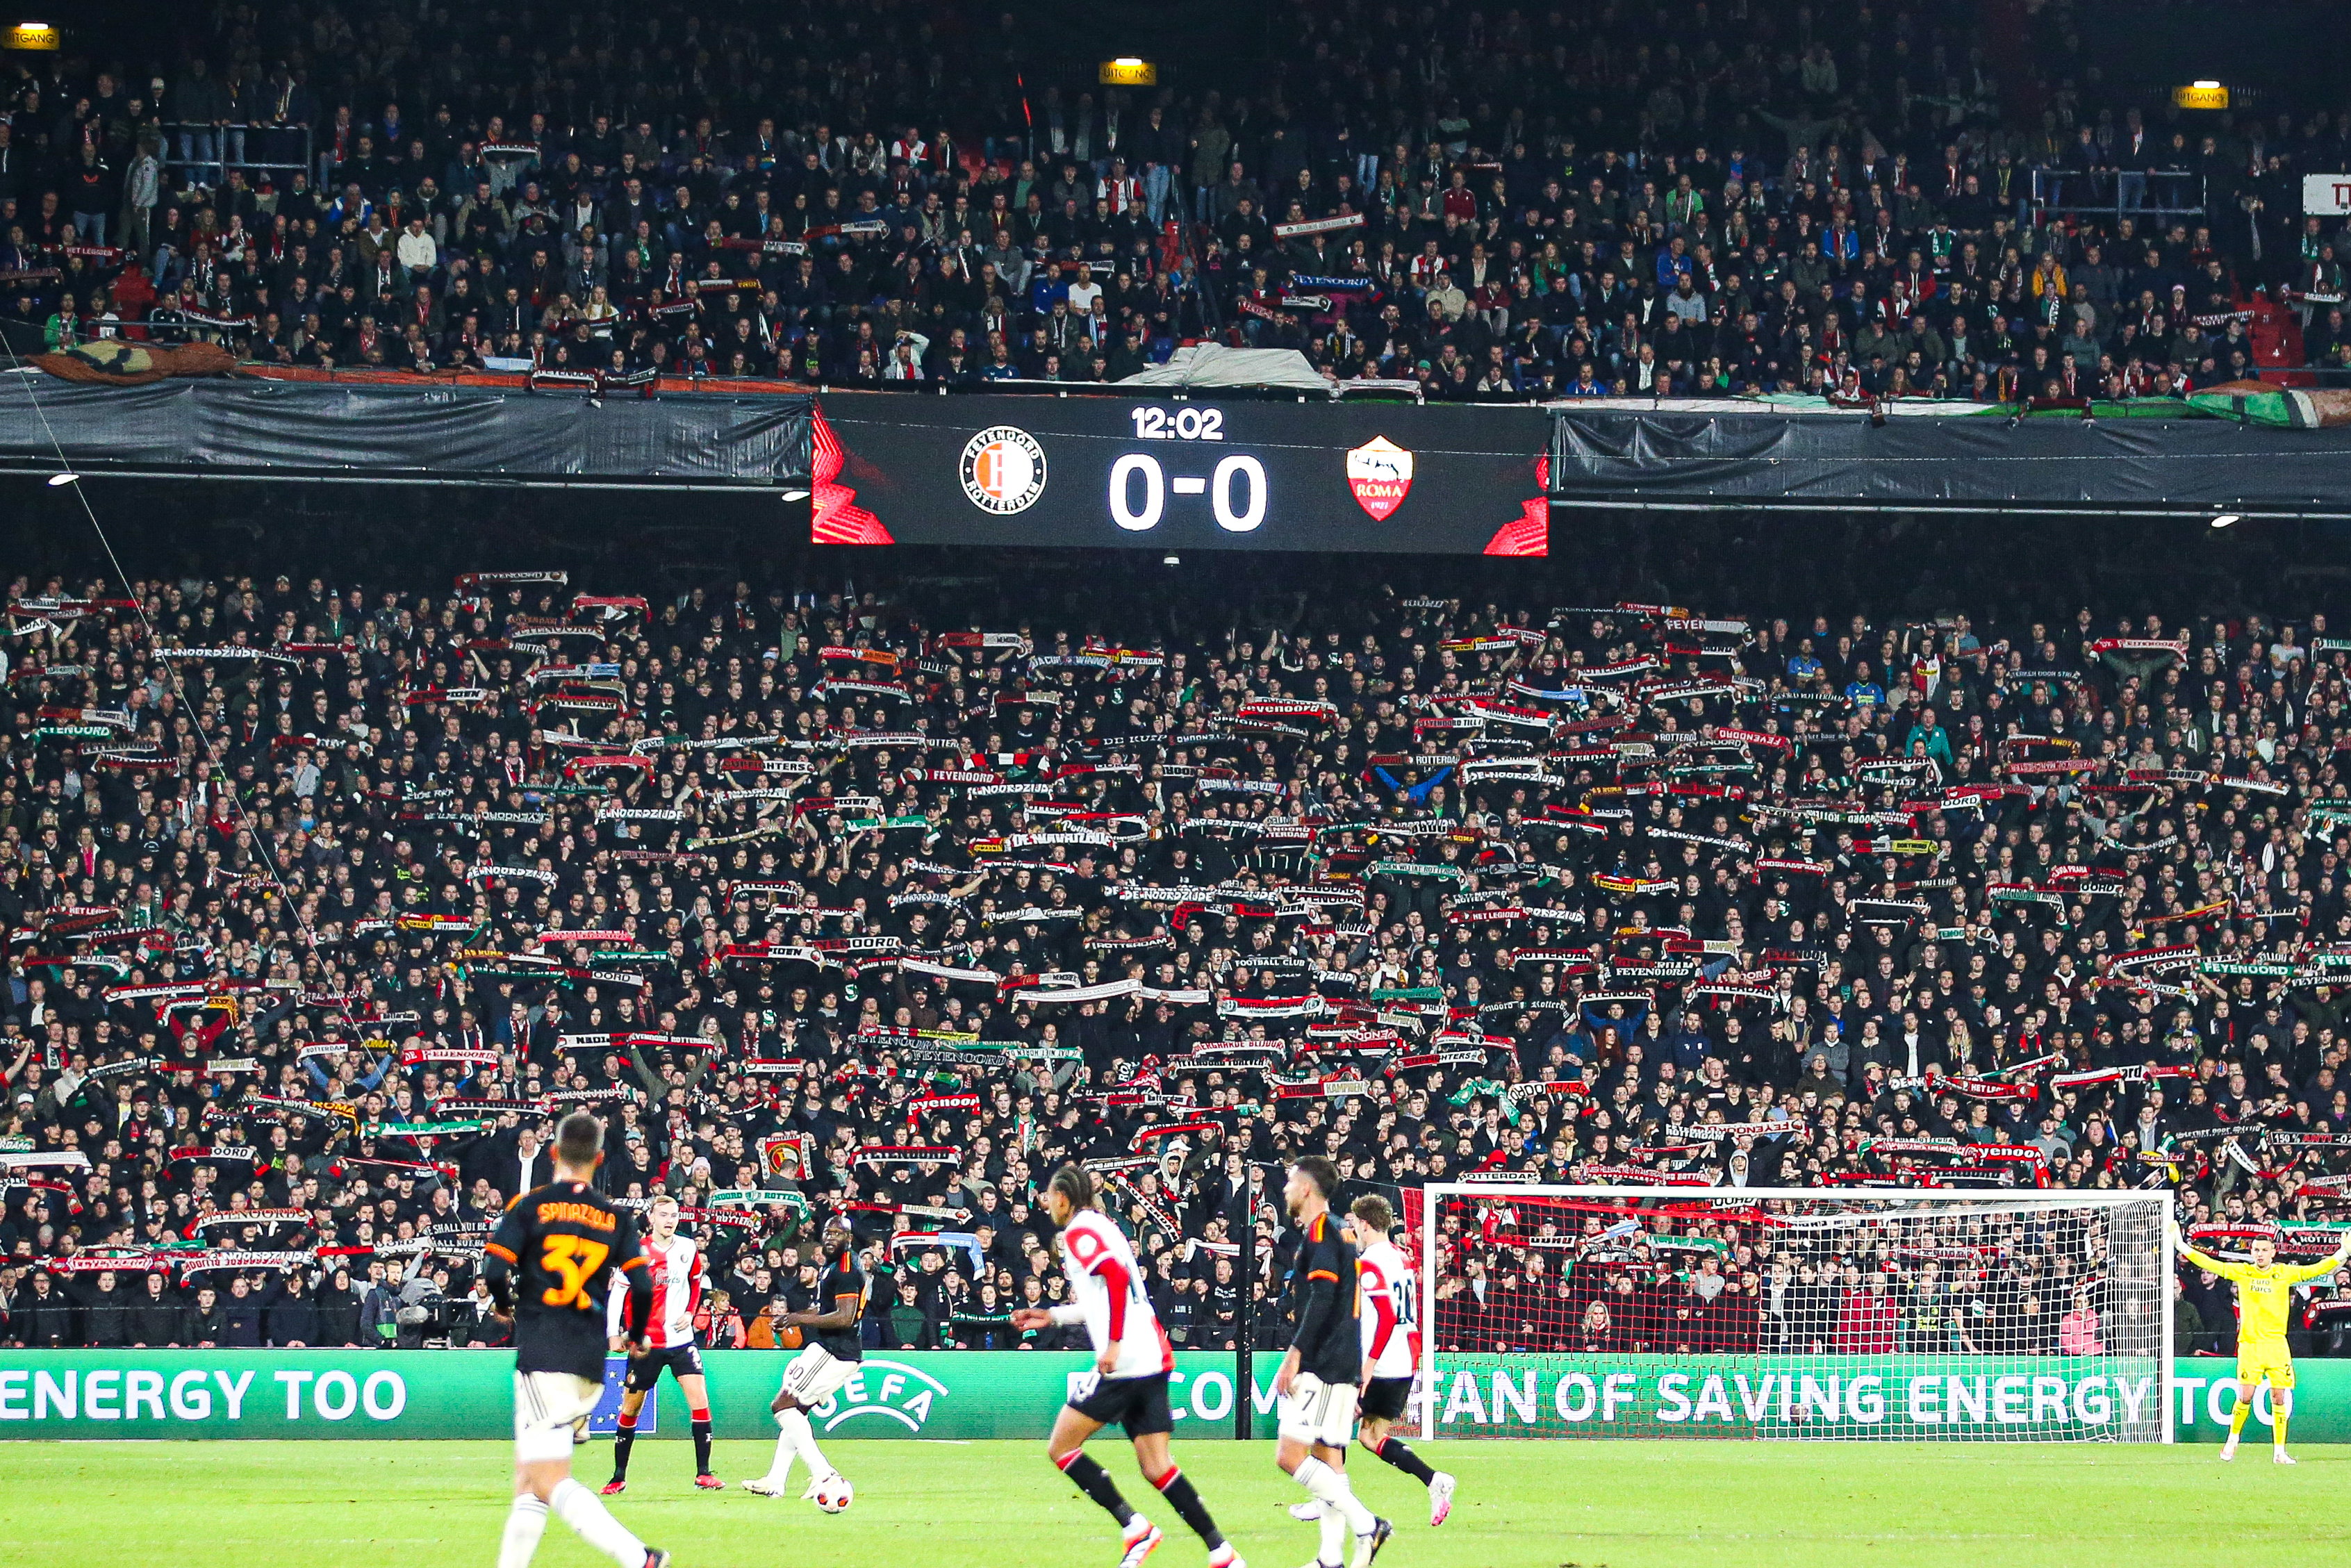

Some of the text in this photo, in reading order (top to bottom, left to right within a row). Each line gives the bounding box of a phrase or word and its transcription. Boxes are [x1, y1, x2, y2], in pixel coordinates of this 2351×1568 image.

[1294, 275, 1368, 286] FEYENOORD
[1132, 406, 1224, 440] 12:02
[967, 424, 1040, 461] FEYENOORD
[967, 479, 1040, 512] ROTTERDAM
[1357, 484, 1402, 498] ROMA
[1474, 639, 1515, 650] ROTTERDAM
[1121, 657, 1164, 666] ROTTERDAM
[1103, 736, 1121, 745] DE
[933, 770, 993, 783] FEYENOORD
[2067, 866, 2087, 874] PRAHA
[1146, 888, 1213, 901] NOORDZIJDE
[1471, 909, 1519, 921] HET LEGIOEN
[1234, 957, 1305, 968] FOOTBALL CLUB
[2204, 962, 2288, 975] FEYENOORD
[306, 1044, 346, 1054] ROTTERDAM
[404, 1049, 417, 1061] DE
[912, 1050, 1005, 1066] FEYENOORD
[762, 1063, 800, 1072] ROTTERDAM
[1325, 1082, 1362, 1095] KAMPIOEN
[1970, 1083, 1985, 1093] HET
[313, 1100, 355, 1114] ROMA
[2274, 1134, 2288, 1144] 150
[172, 1146, 247, 1160] FEYENOORD
[536, 1201, 616, 1232] SPINAZZOLA
[434, 1223, 459, 1235] SHALL
[461, 1222, 473, 1233] NOT
[476, 1222, 486, 1232] BE
[542, 1234, 610, 1310] 37
[0, 1370, 409, 1420] ENERGY TOO
[1304, 1389, 1317, 1412] 7
[1555, 1373, 1637, 1423] OF
[1656, 1375, 1883, 1423] SAVING
[1911, 1376, 2153, 1425] ENERGY
